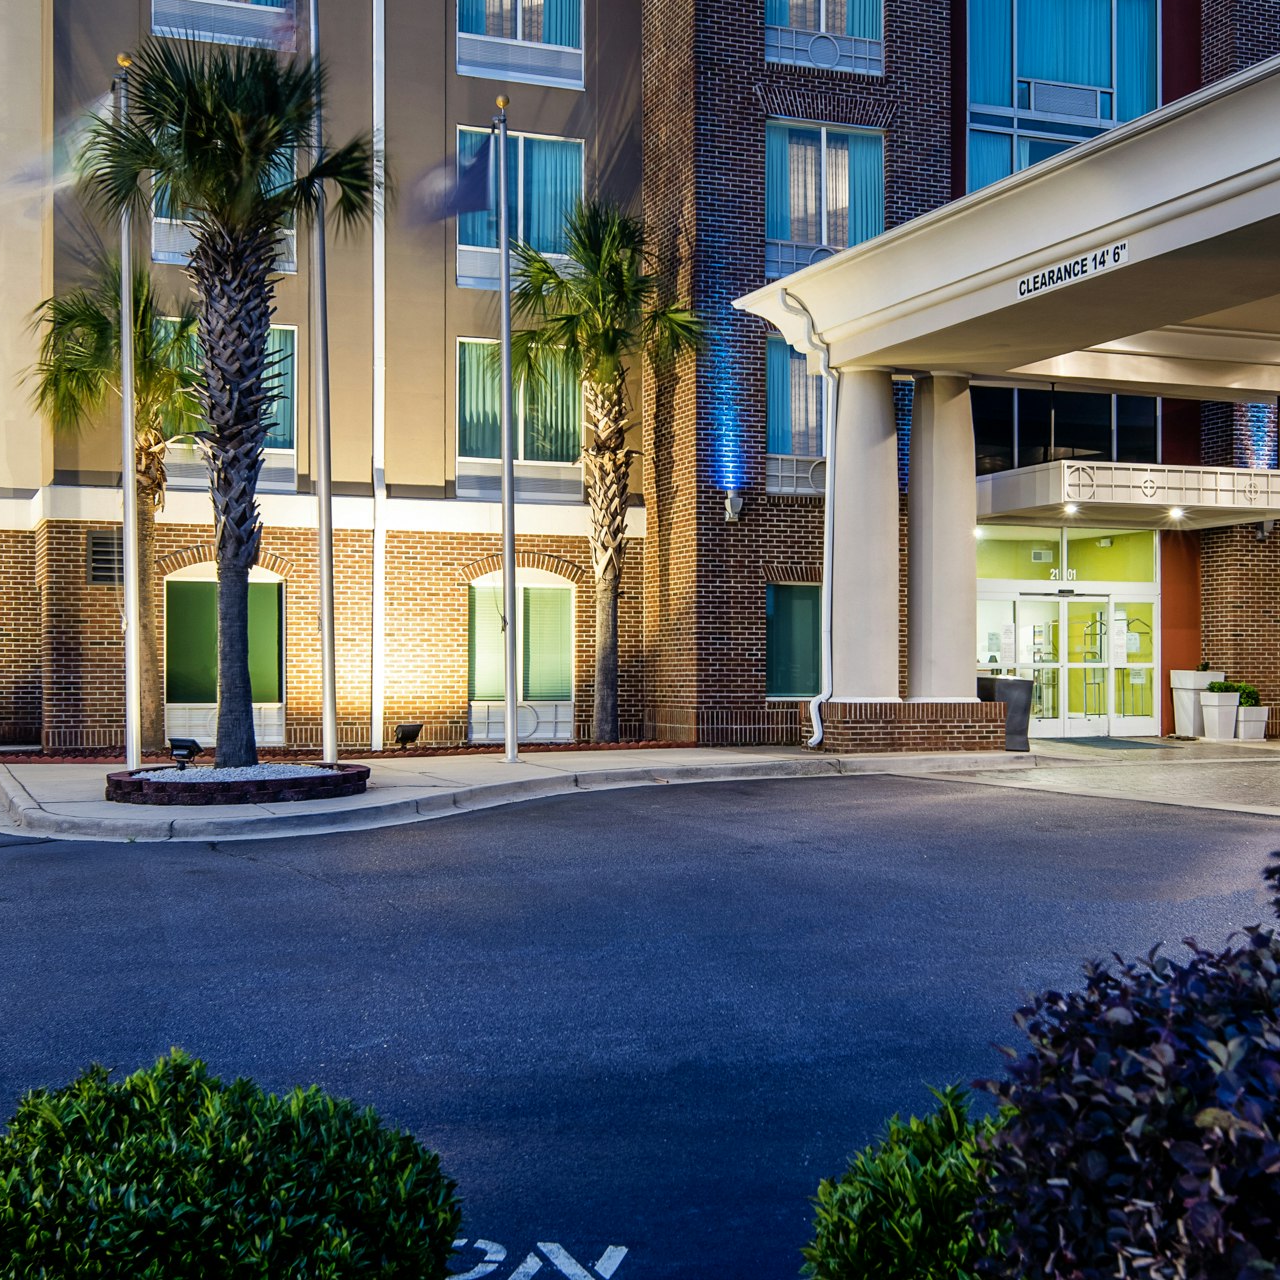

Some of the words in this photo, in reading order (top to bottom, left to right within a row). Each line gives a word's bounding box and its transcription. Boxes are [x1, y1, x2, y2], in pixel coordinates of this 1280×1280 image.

[1019, 257, 1088, 296] CLEARANCE
[1091, 249, 1109, 270] 14'
[1113, 243, 1126, 263] 6"
